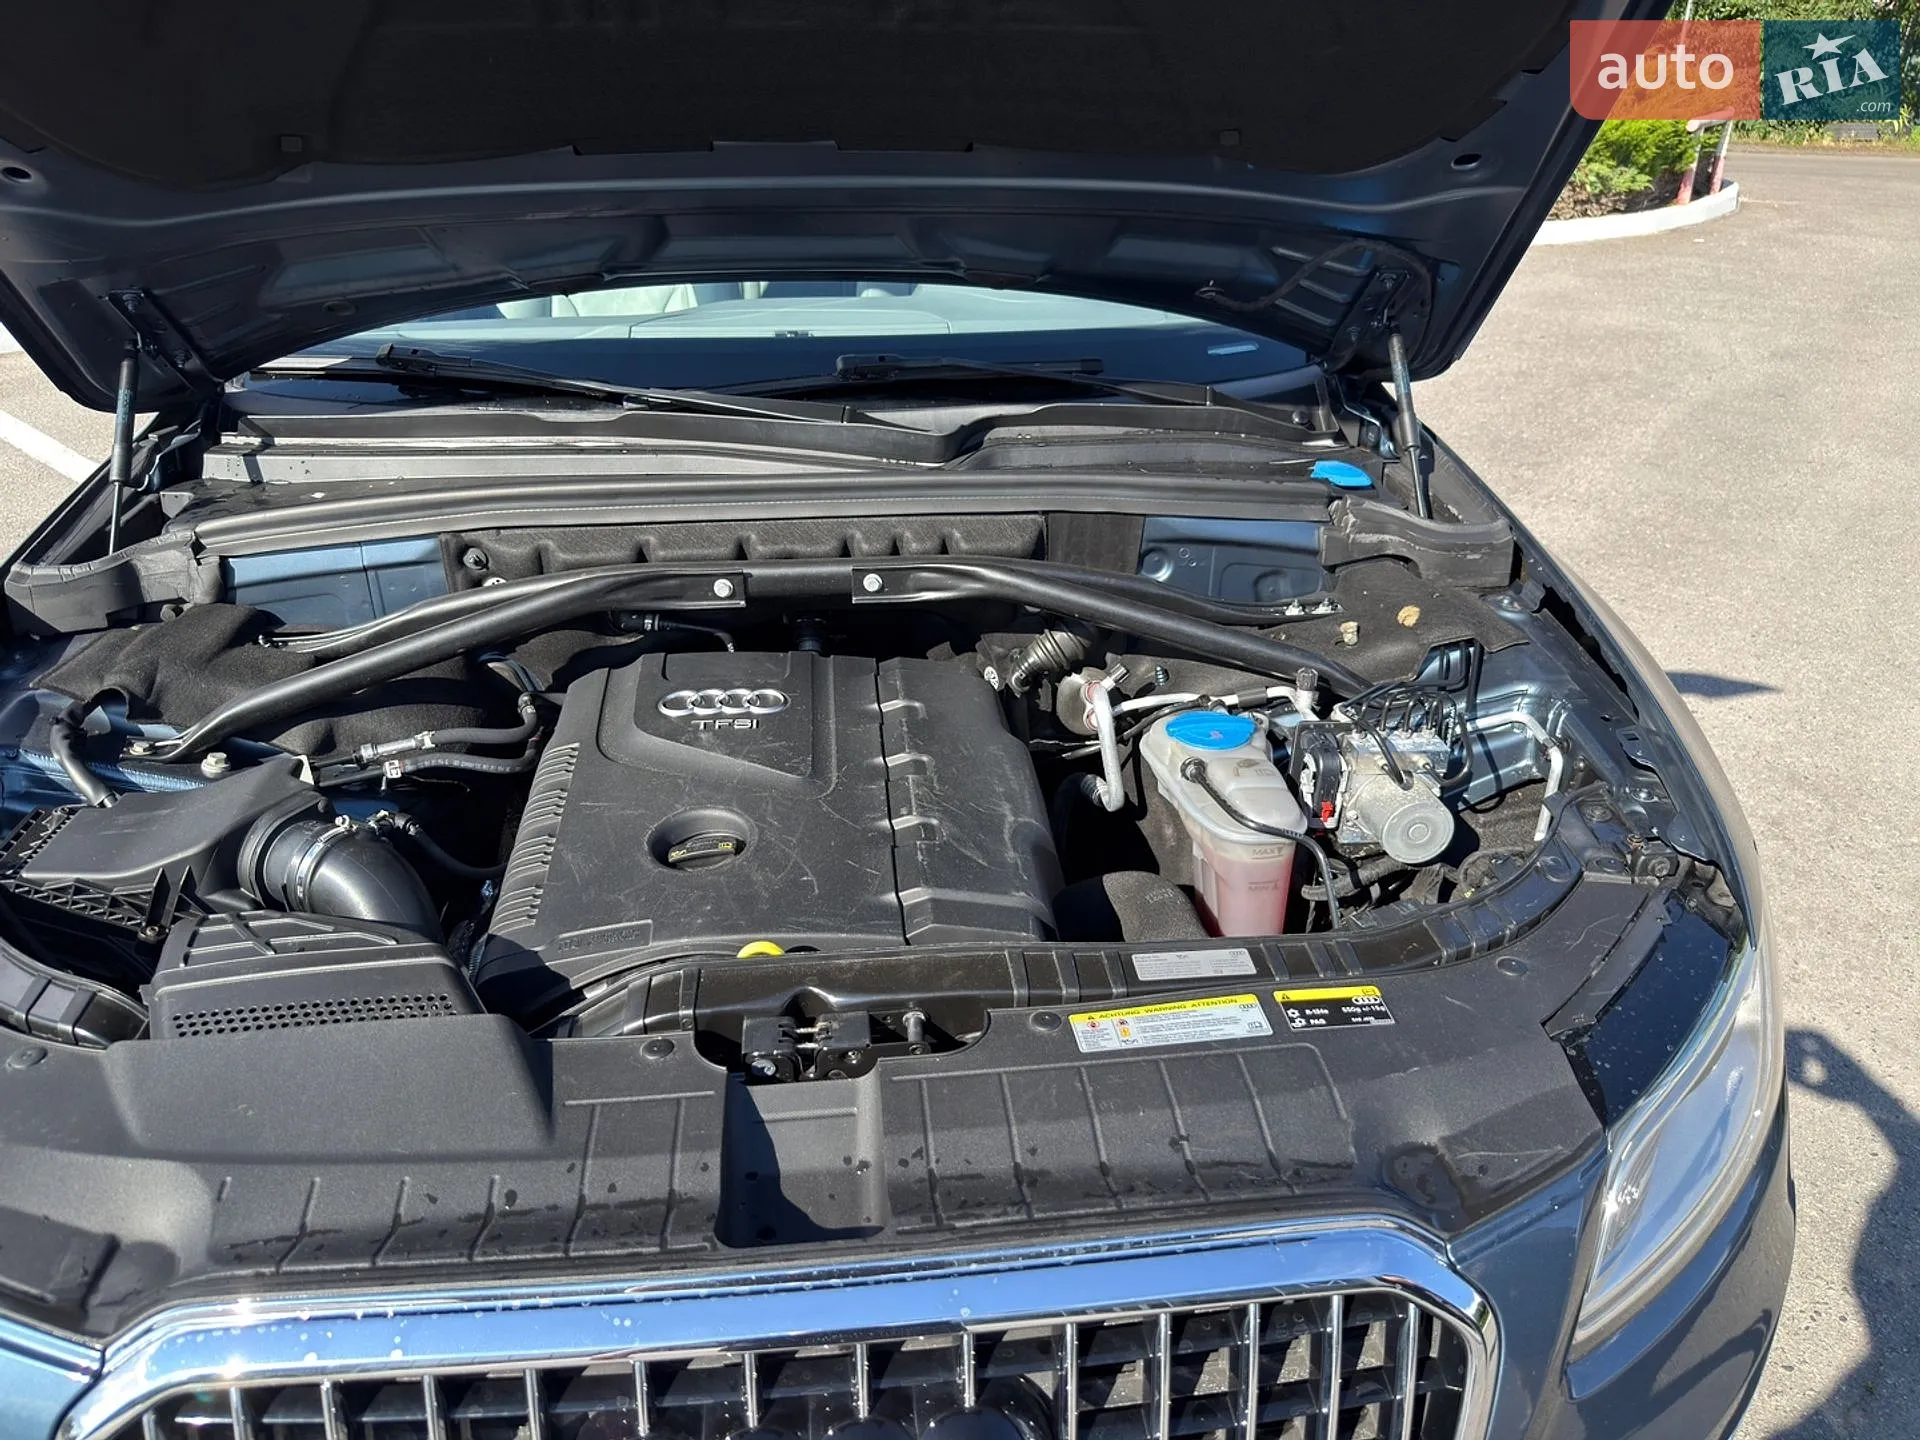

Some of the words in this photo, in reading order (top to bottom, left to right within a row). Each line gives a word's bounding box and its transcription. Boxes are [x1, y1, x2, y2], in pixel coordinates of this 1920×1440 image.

[691, 719, 759, 730] TFSI
[1252, 847, 1275, 856] MAX
[1099, 1009, 1141, 1019] ACHTUNG
[1144, 1004, 1187, 1014] WARNING
[1191, 998, 1238, 1009] ATTENTION
